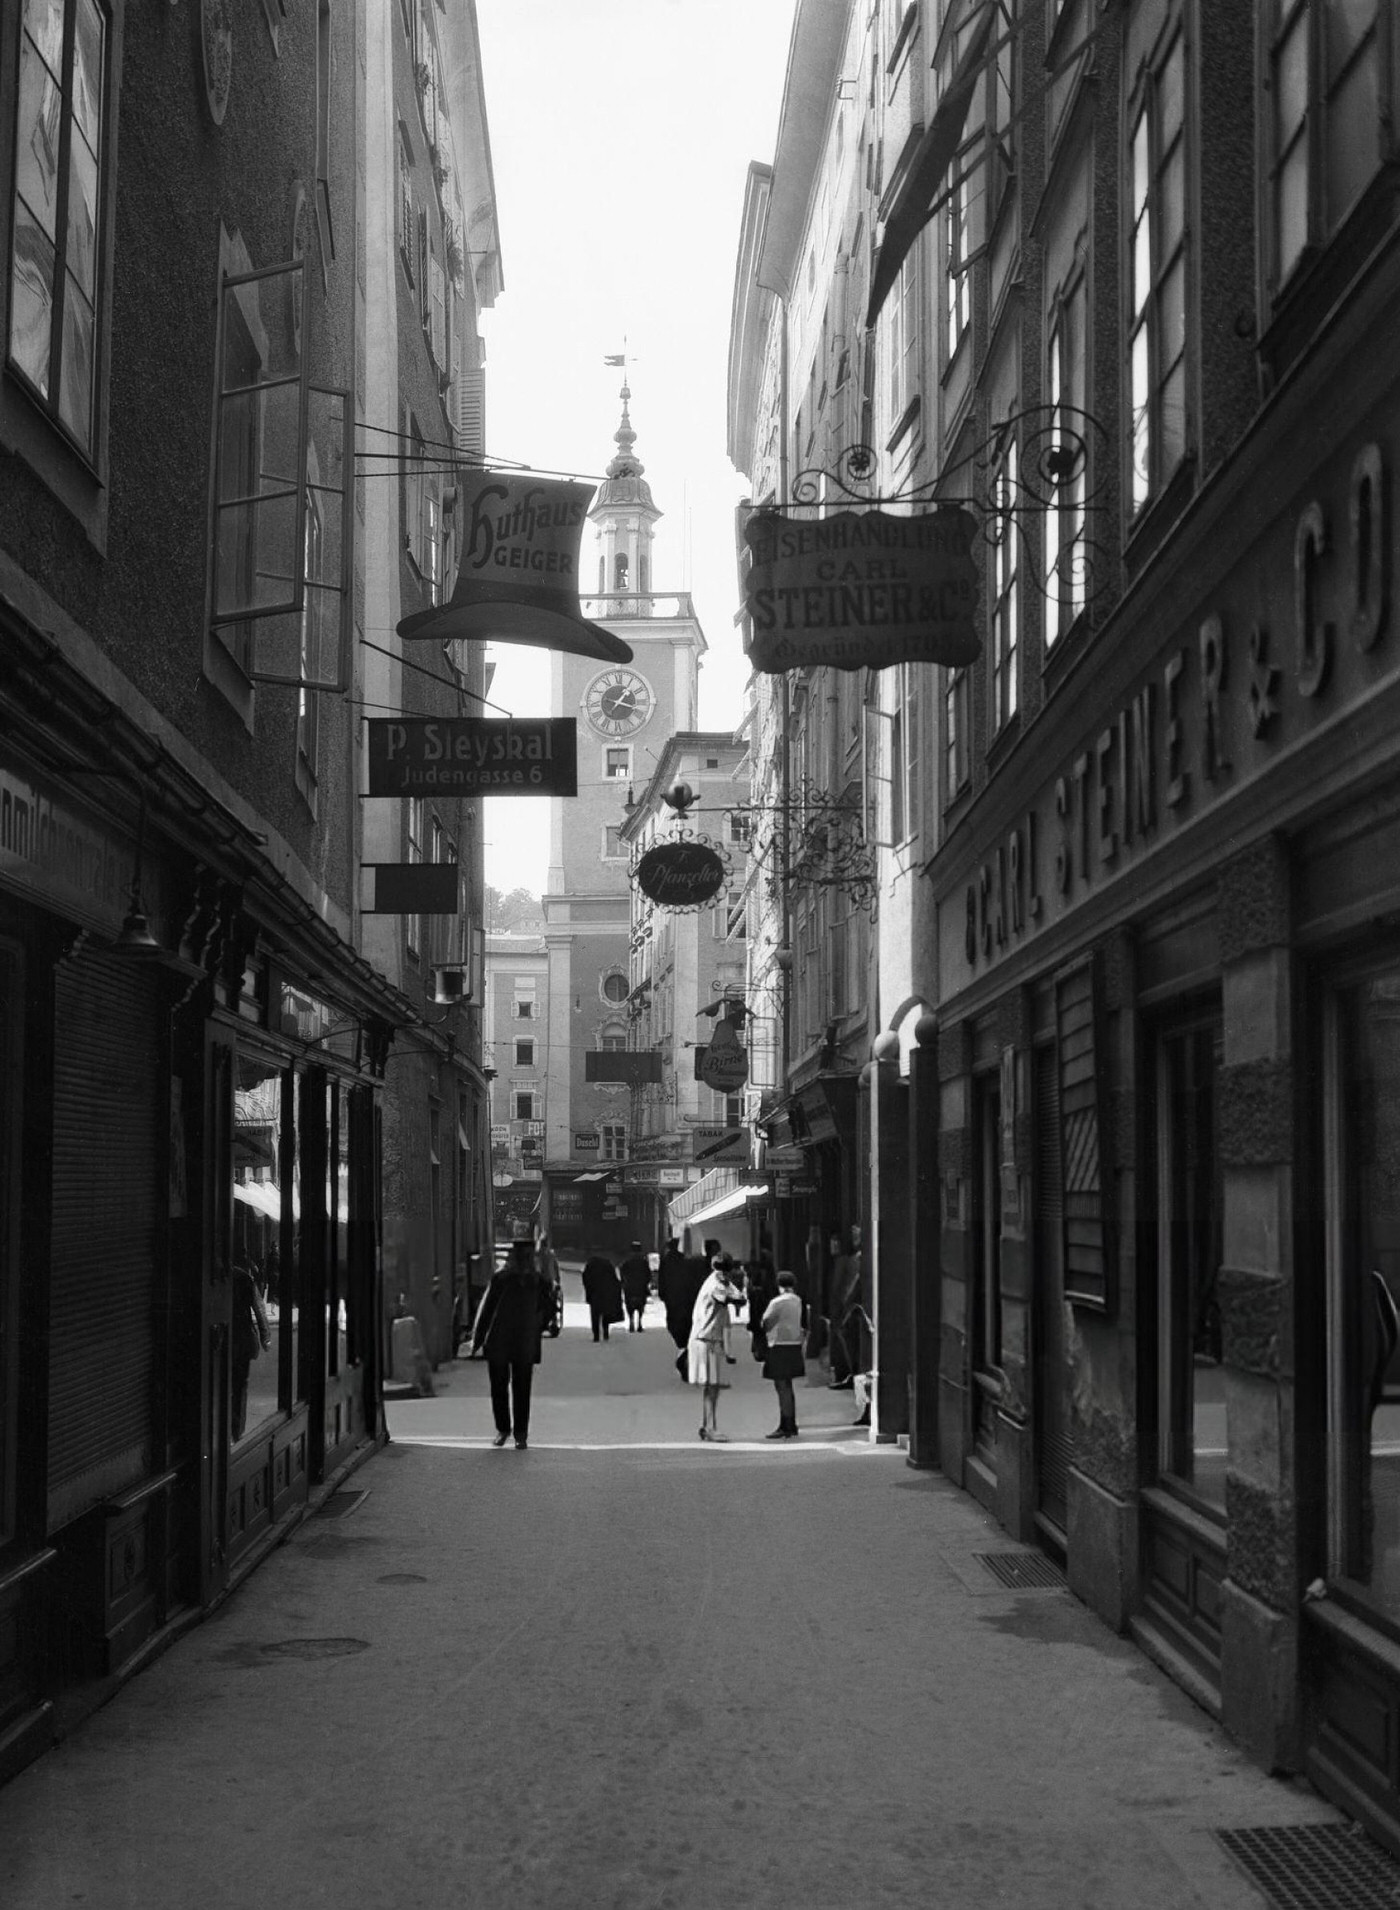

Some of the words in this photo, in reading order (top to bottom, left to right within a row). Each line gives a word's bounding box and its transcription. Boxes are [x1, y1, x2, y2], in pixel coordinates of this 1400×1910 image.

[467, 484, 583, 569] Huthaus
[755, 519, 970, 567] EISENHANDLUNG
[494, 545, 572, 574] GEIGER
[816, 557, 908, 582] CARL
[755, 582, 914, 630] STEINER
[386, 724, 411, 761] P.
[400, 764, 523, 789] Judengasse
[529, 764, 543, 784] 6
[978, 811, 1042, 958] CARL
[1053, 612, 1232, 892] STEINER
[1249, 620, 1282, 741] &
